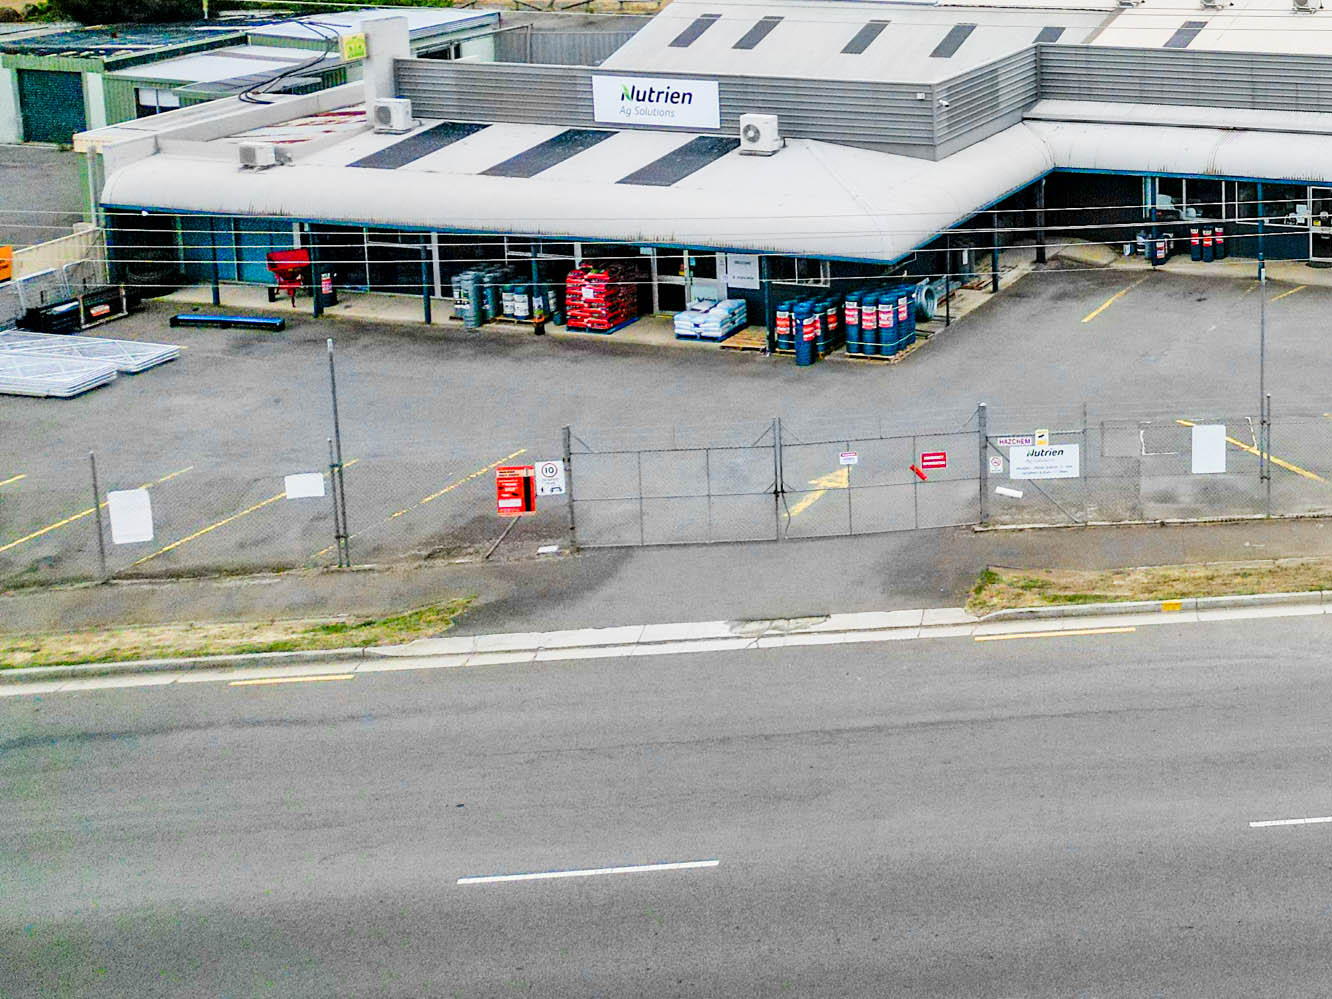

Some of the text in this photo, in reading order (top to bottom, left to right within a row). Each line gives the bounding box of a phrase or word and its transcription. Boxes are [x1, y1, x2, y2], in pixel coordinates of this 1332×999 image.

[620, 84, 693, 105] Nutrien
[619, 105, 675, 118] Ag Solutions
[1026, 448, 1064, 457] Nutrien
[544, 466, 555, 474] 10
